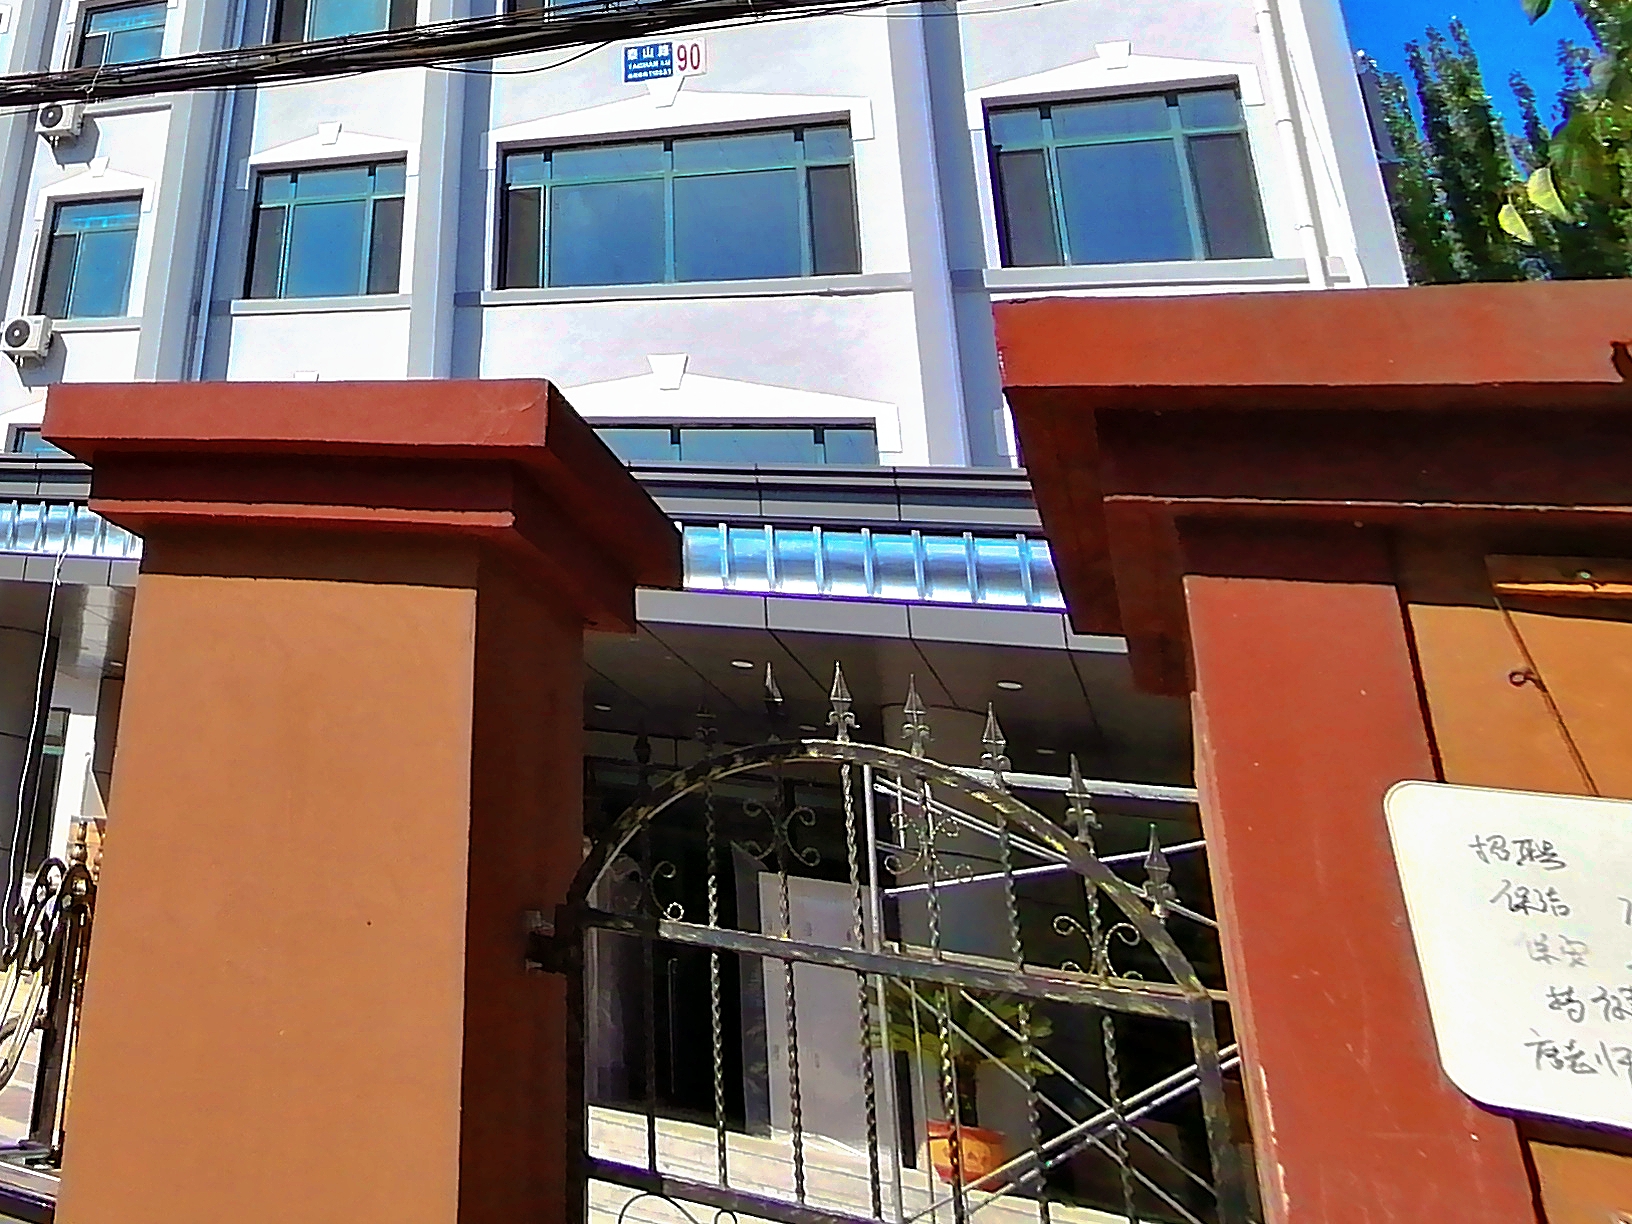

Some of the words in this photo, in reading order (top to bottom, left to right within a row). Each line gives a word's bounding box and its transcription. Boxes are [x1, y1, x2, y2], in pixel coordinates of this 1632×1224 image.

[677, 42, 701, 72] 90
[1467, 833, 1568, 872] 招聘
[1488, 878, 1572, 918] 保洁
